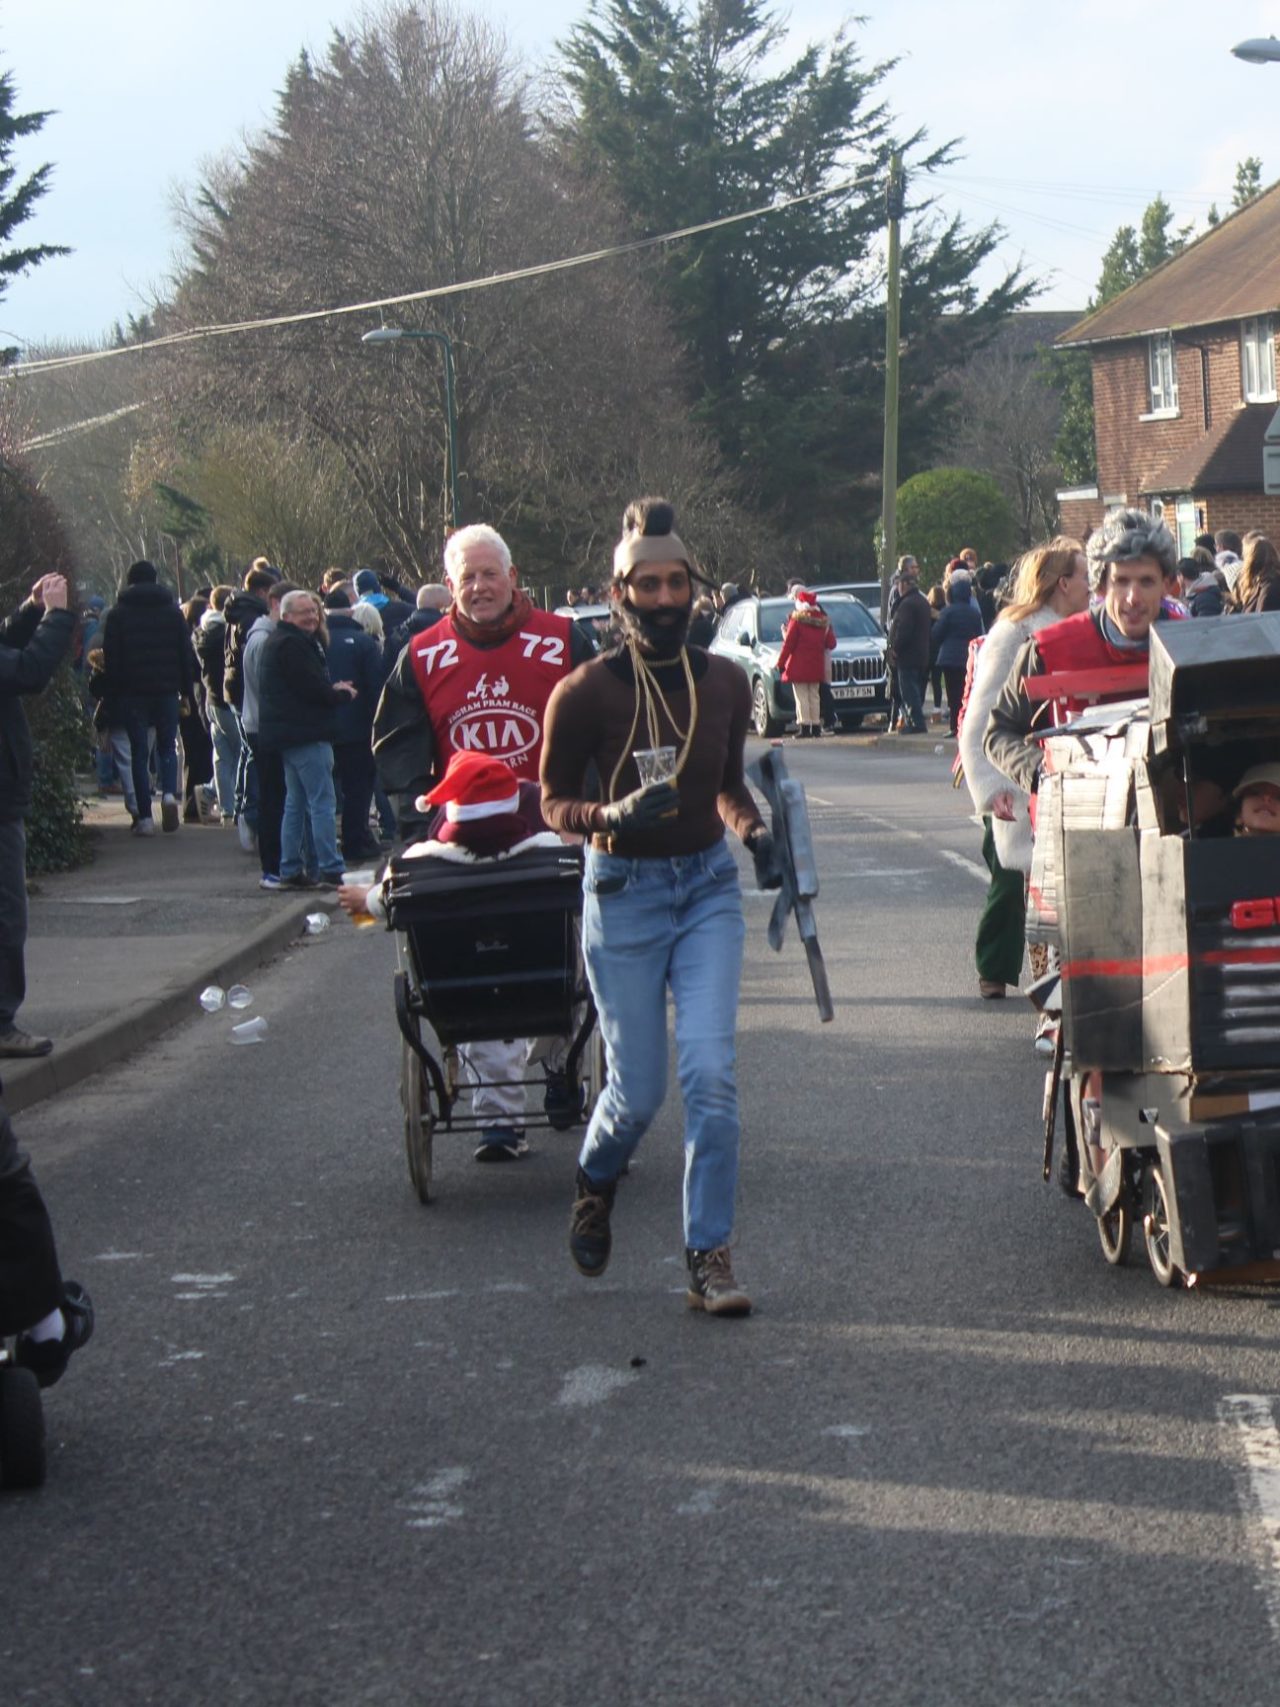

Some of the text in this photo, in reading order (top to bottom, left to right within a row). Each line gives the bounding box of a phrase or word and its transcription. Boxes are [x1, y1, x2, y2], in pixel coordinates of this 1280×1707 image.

[417, 639, 459, 675] 72
[519, 632, 565, 666] 72
[483, 699, 511, 708] PRAM
[512, 702, 537, 718] RACE
[459, 720, 525, 750] KIA
